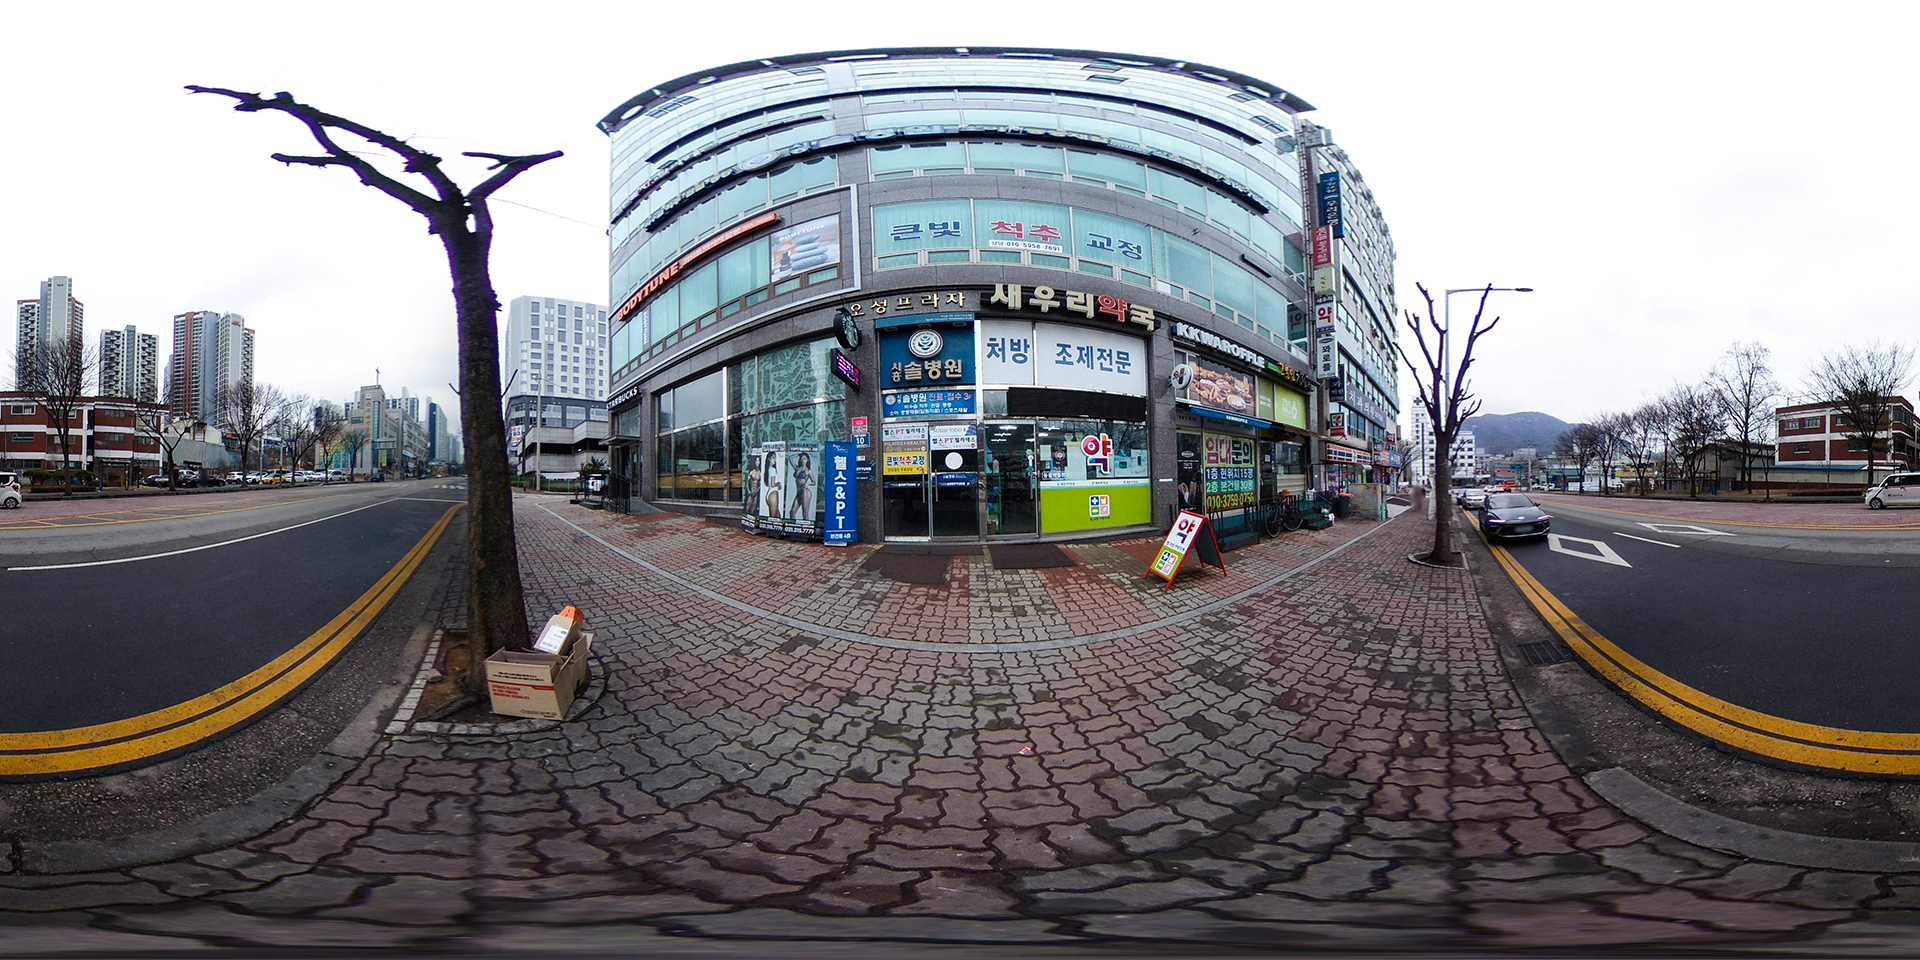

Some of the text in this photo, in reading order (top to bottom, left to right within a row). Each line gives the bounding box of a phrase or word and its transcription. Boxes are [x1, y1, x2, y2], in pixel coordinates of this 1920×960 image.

[778, 224, 825, 242] BODYTUNE
[890, 221, 1144, 261] 큰빛 척추 교정
[617, 261, 681, 323] BODYTUNE
[849, 292, 966, 317] 오성프라자
[990, 283, 1156, 331] 새우리약국
[1318, 306, 1333, 323] 약
[986, 337, 1132, 375] 처방 조제전문
[1176, 322, 1266, 369] KKWAROFFLE
[904, 359, 963, 381] 솔병원
[856, 437, 865, 445] 10
[1081, 433, 1112, 474] 약
[1205, 436, 1254, 465] 임대문의
[1177, 519, 1196, 544] 약
